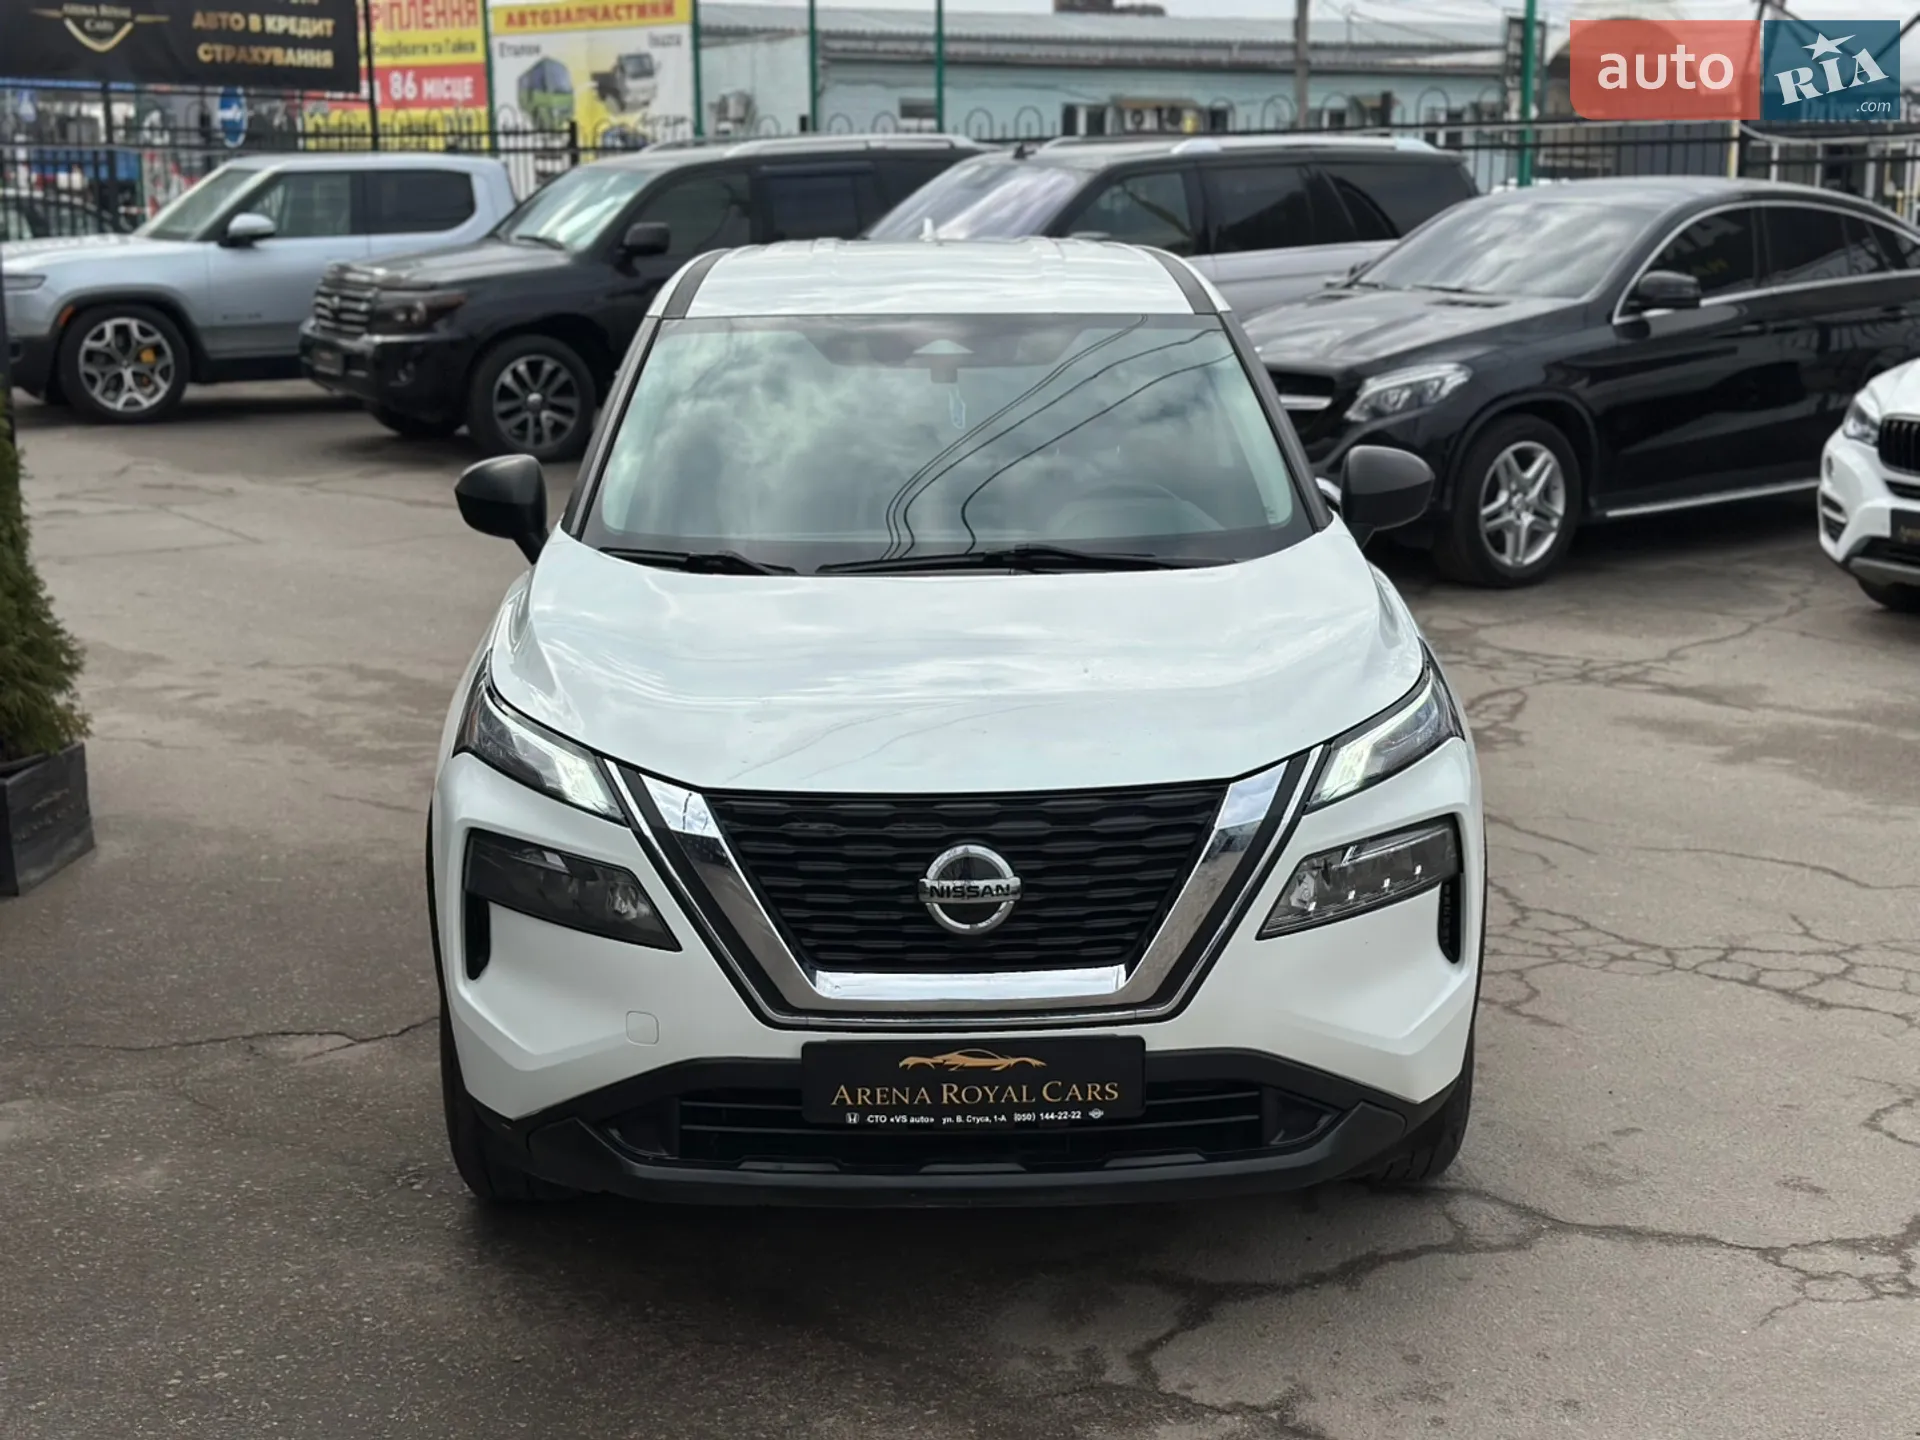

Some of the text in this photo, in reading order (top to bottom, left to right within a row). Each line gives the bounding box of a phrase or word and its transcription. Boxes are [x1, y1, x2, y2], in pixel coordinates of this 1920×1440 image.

[193, 12, 335, 38] АВТО В КРЕДИТ
[505, 1, 675, 27] АВТОЗАПЧАСТИНИ
[197, 43, 334, 69] СТРАХУВАННЯ
[389, 70, 418, 101] 86
[421, 77, 473, 104] МІСЦЕ
[929, 884, 1010, 898] NISSAN
[867, 1114, 888, 1124] СТО
[1014, 1112, 1036, 1122] (050)
[1040, 1110, 1082, 1121] 144-22-22
